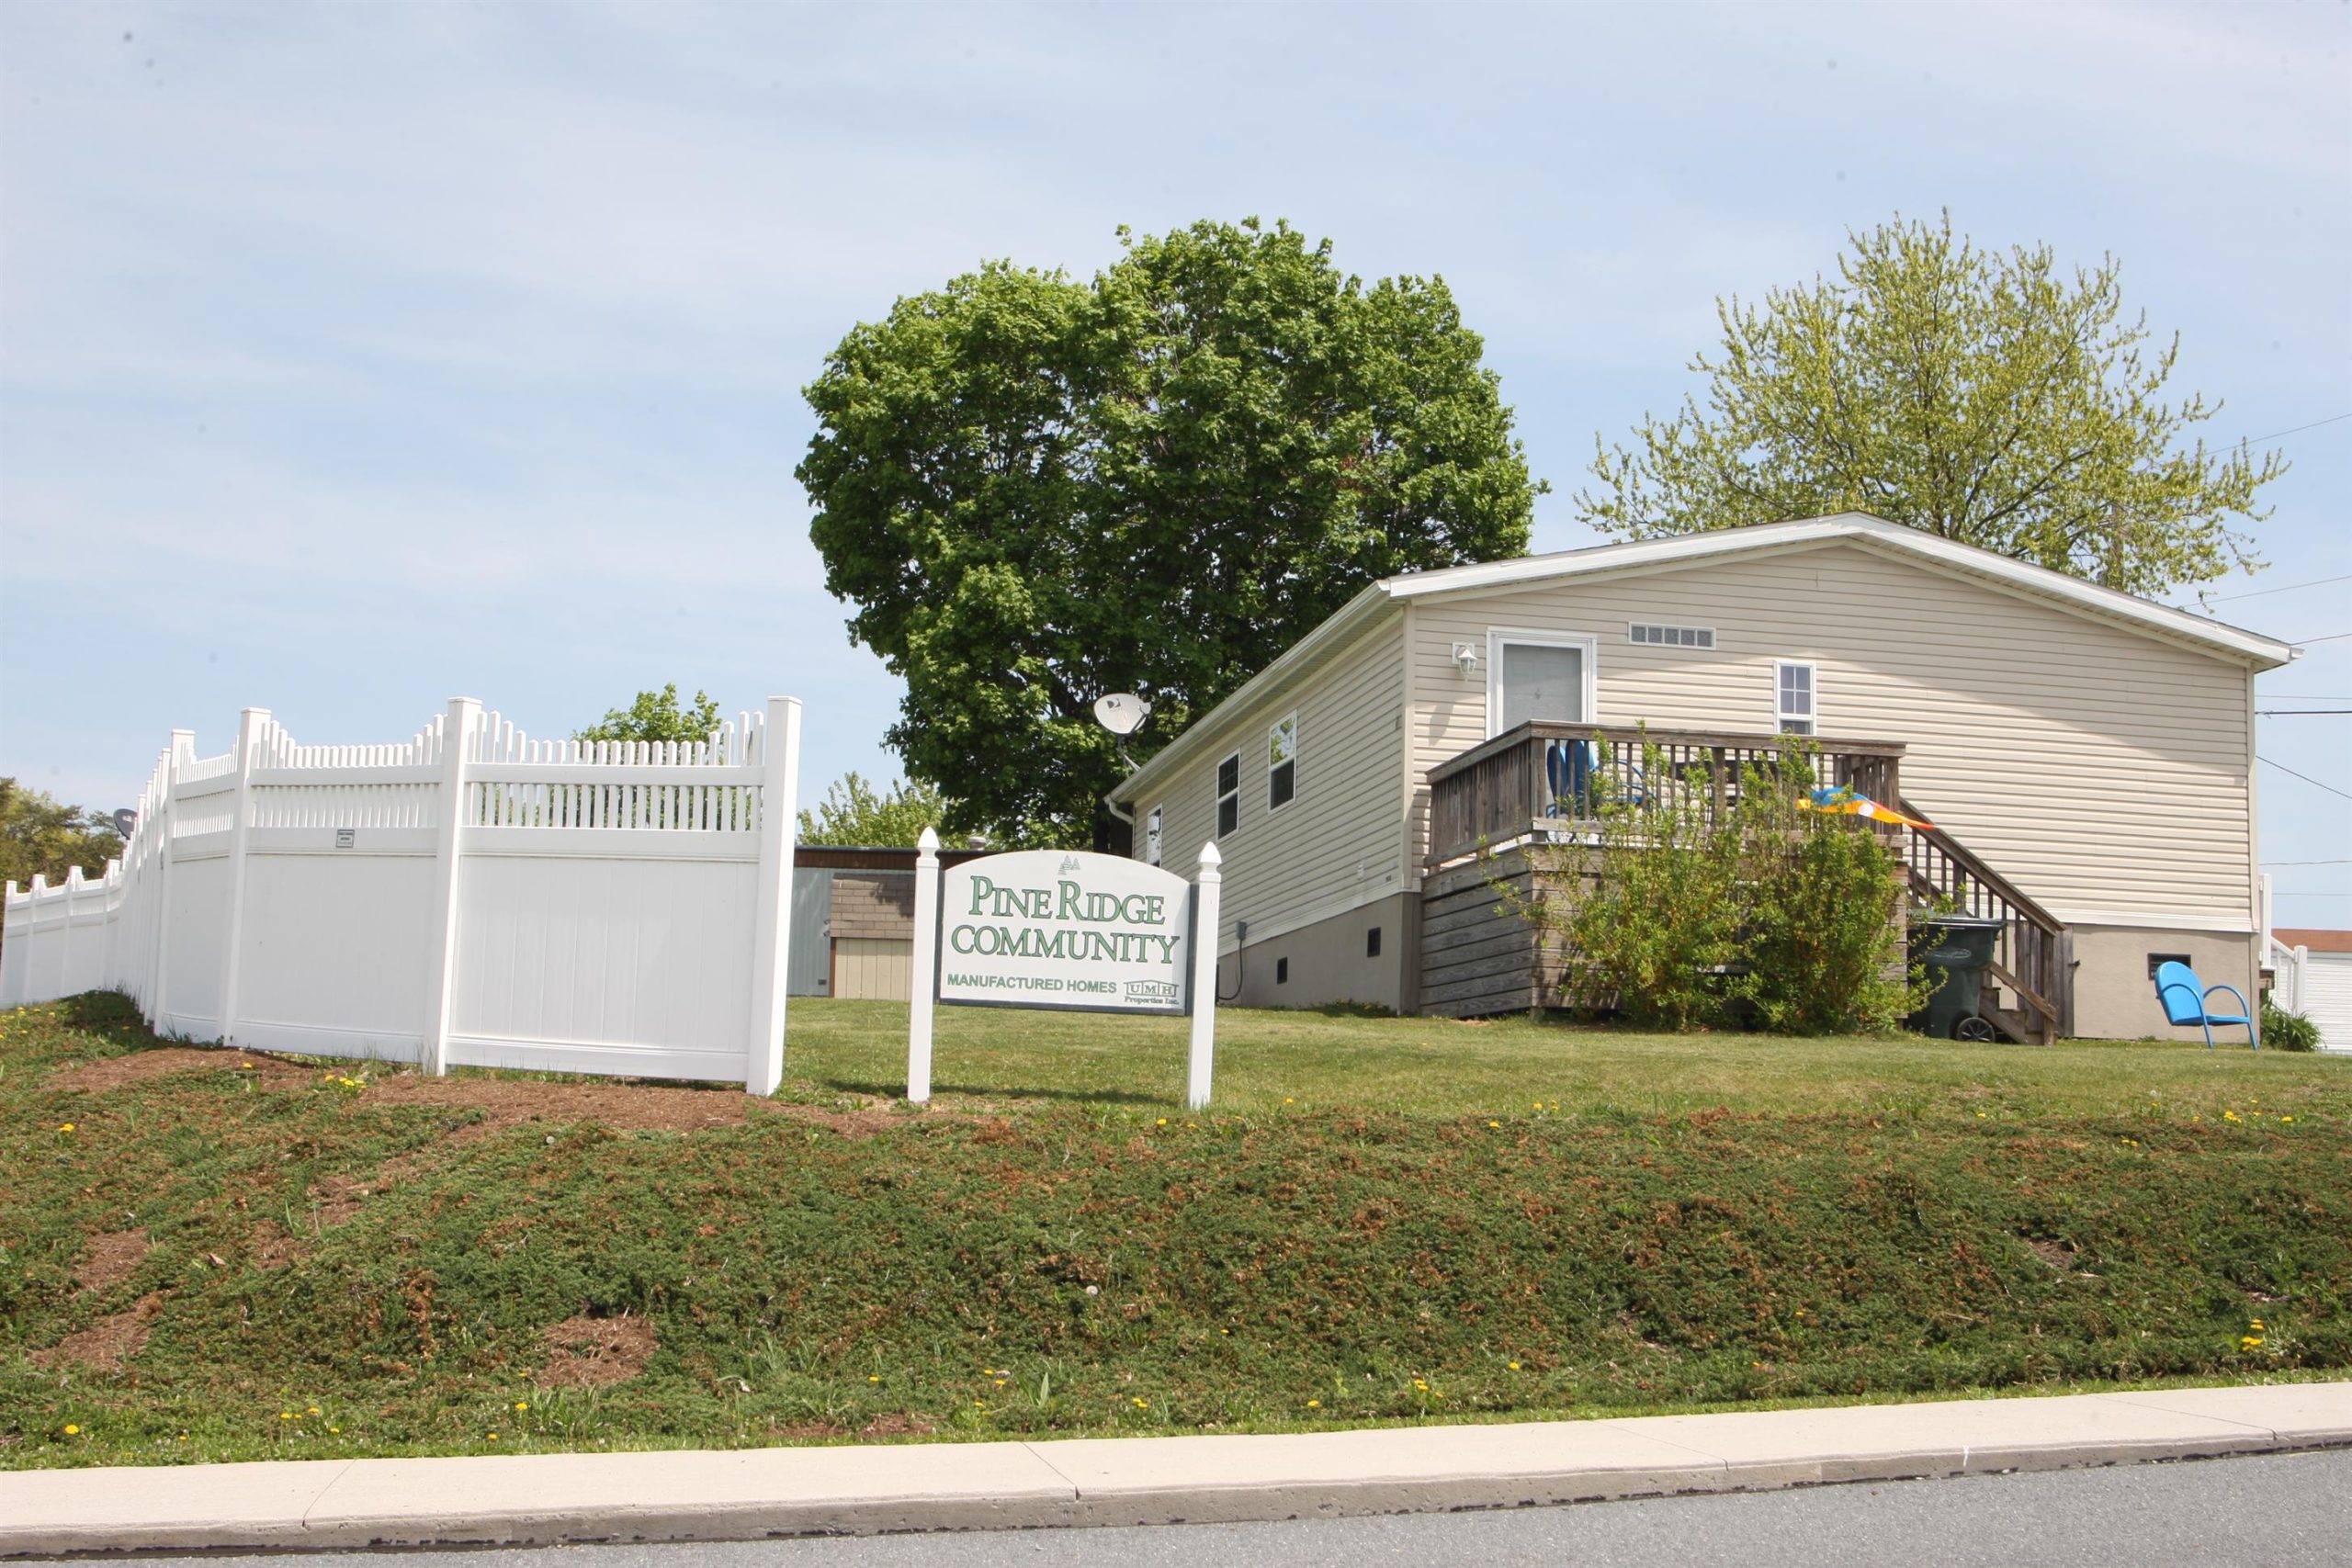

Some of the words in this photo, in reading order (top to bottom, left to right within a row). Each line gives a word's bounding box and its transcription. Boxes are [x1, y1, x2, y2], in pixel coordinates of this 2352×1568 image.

[968, 875, 1053, 919] PINE
[1056, 880, 1166, 925] RIDGE
[951, 924, 1180, 964] COMMUNITY
[947, 974, 1063, 991] MANUFACTURED
[1067, 980, 1117, 994] HOMES
[1125, 996, 1163, 1005] Properties
